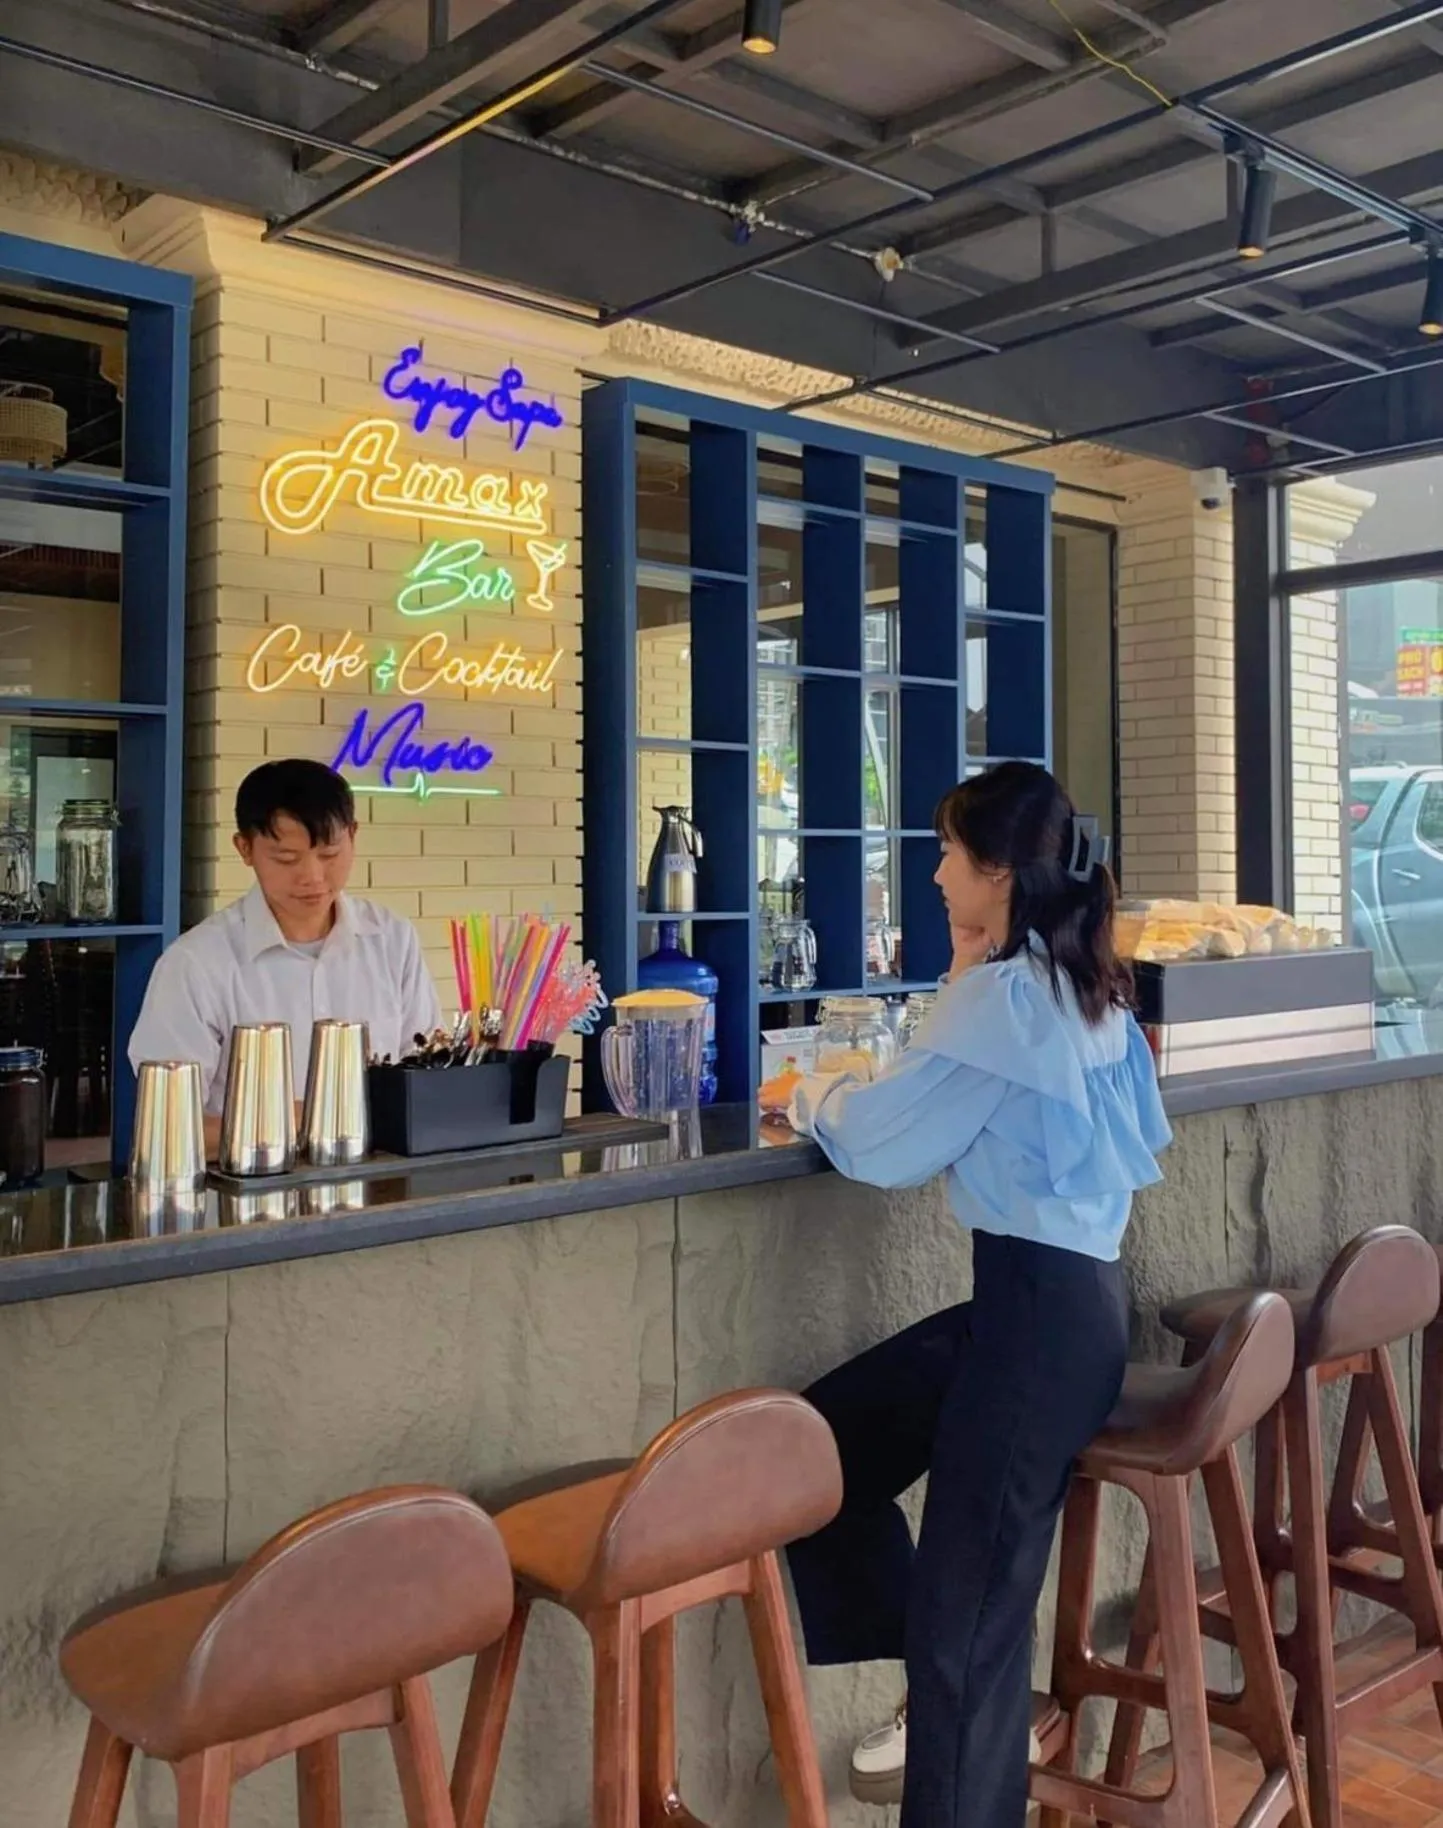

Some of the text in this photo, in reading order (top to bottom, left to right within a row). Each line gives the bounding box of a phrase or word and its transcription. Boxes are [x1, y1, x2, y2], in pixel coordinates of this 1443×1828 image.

[260, 418, 548, 535] Amax
[398, 539, 514, 615] Bar
[247, 624, 564, 695] Café & Cocktail
[331, 702, 493, 786] Music
